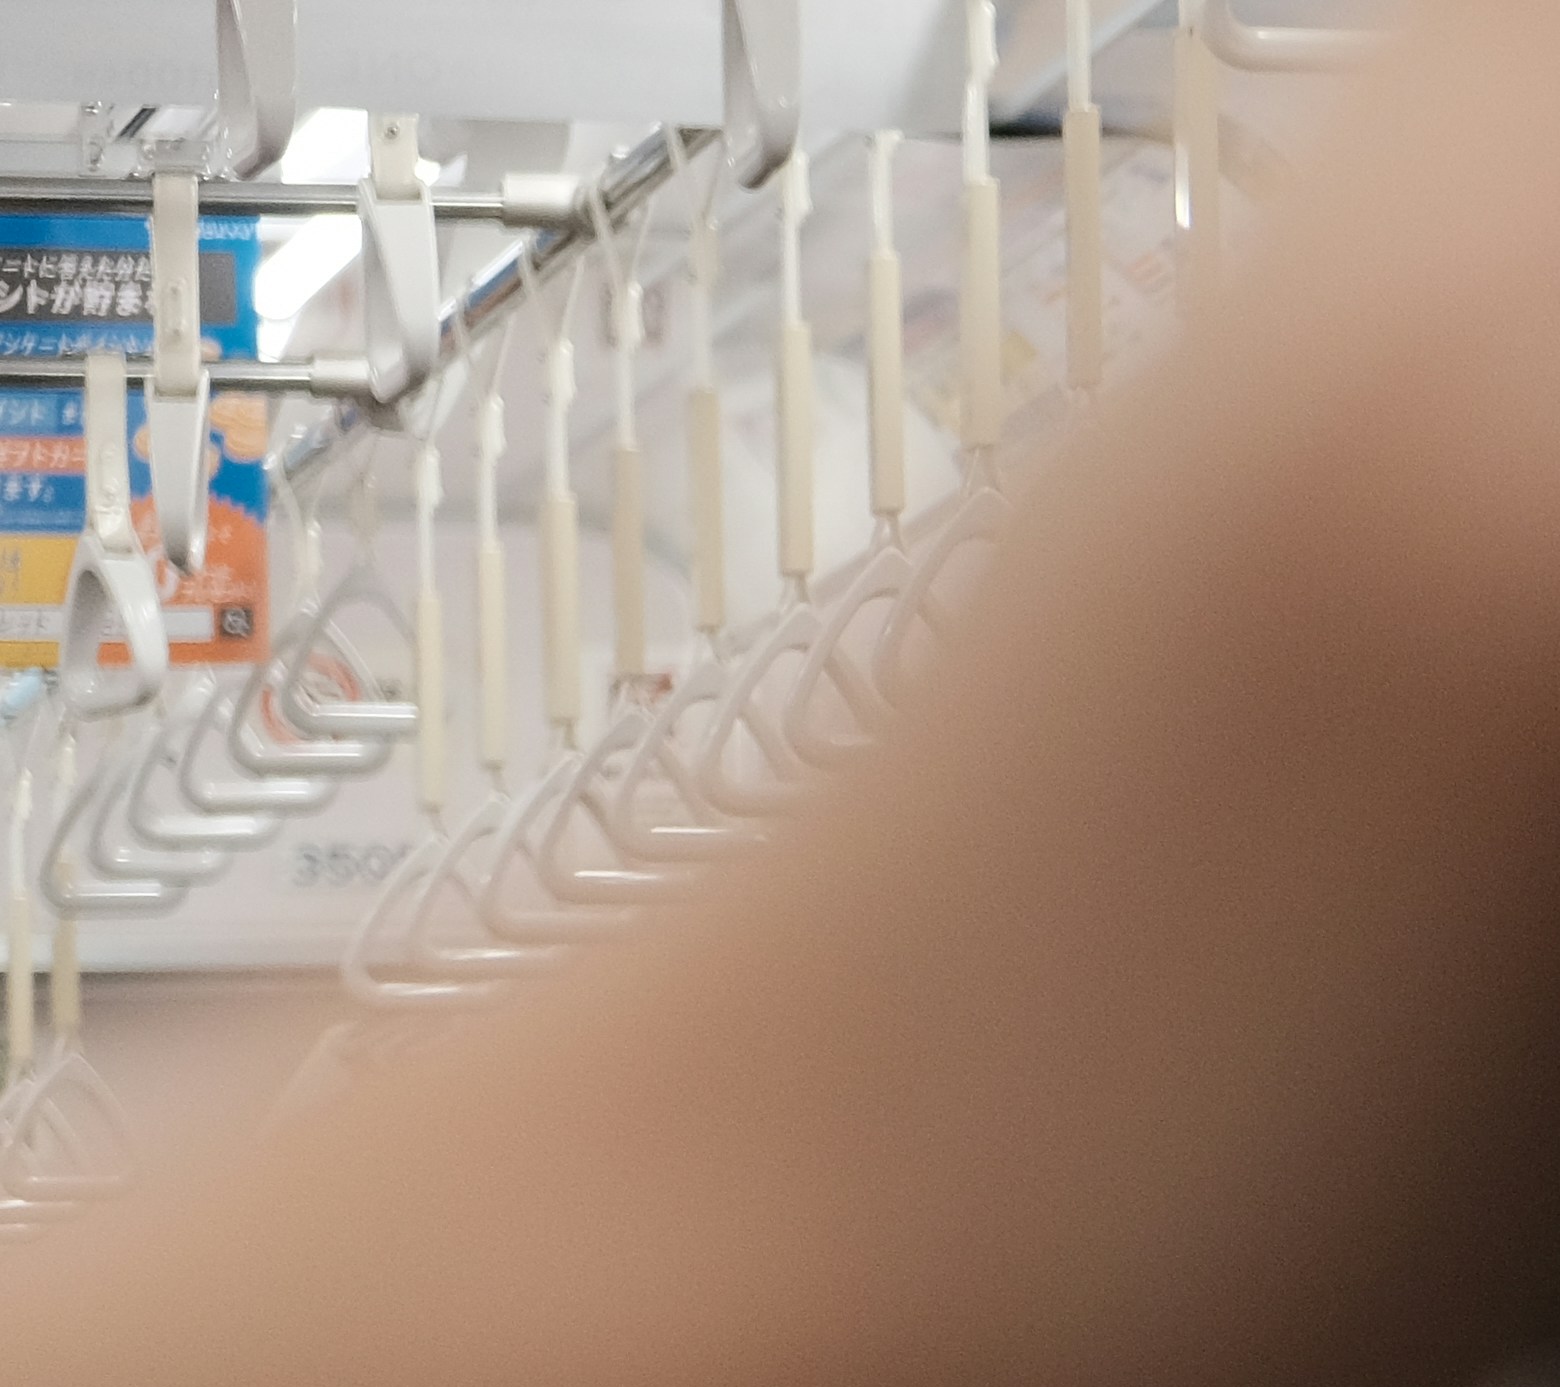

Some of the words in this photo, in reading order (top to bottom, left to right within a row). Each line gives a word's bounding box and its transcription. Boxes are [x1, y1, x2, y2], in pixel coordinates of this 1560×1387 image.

[0, 279, 155, 317] ントが貯ま
